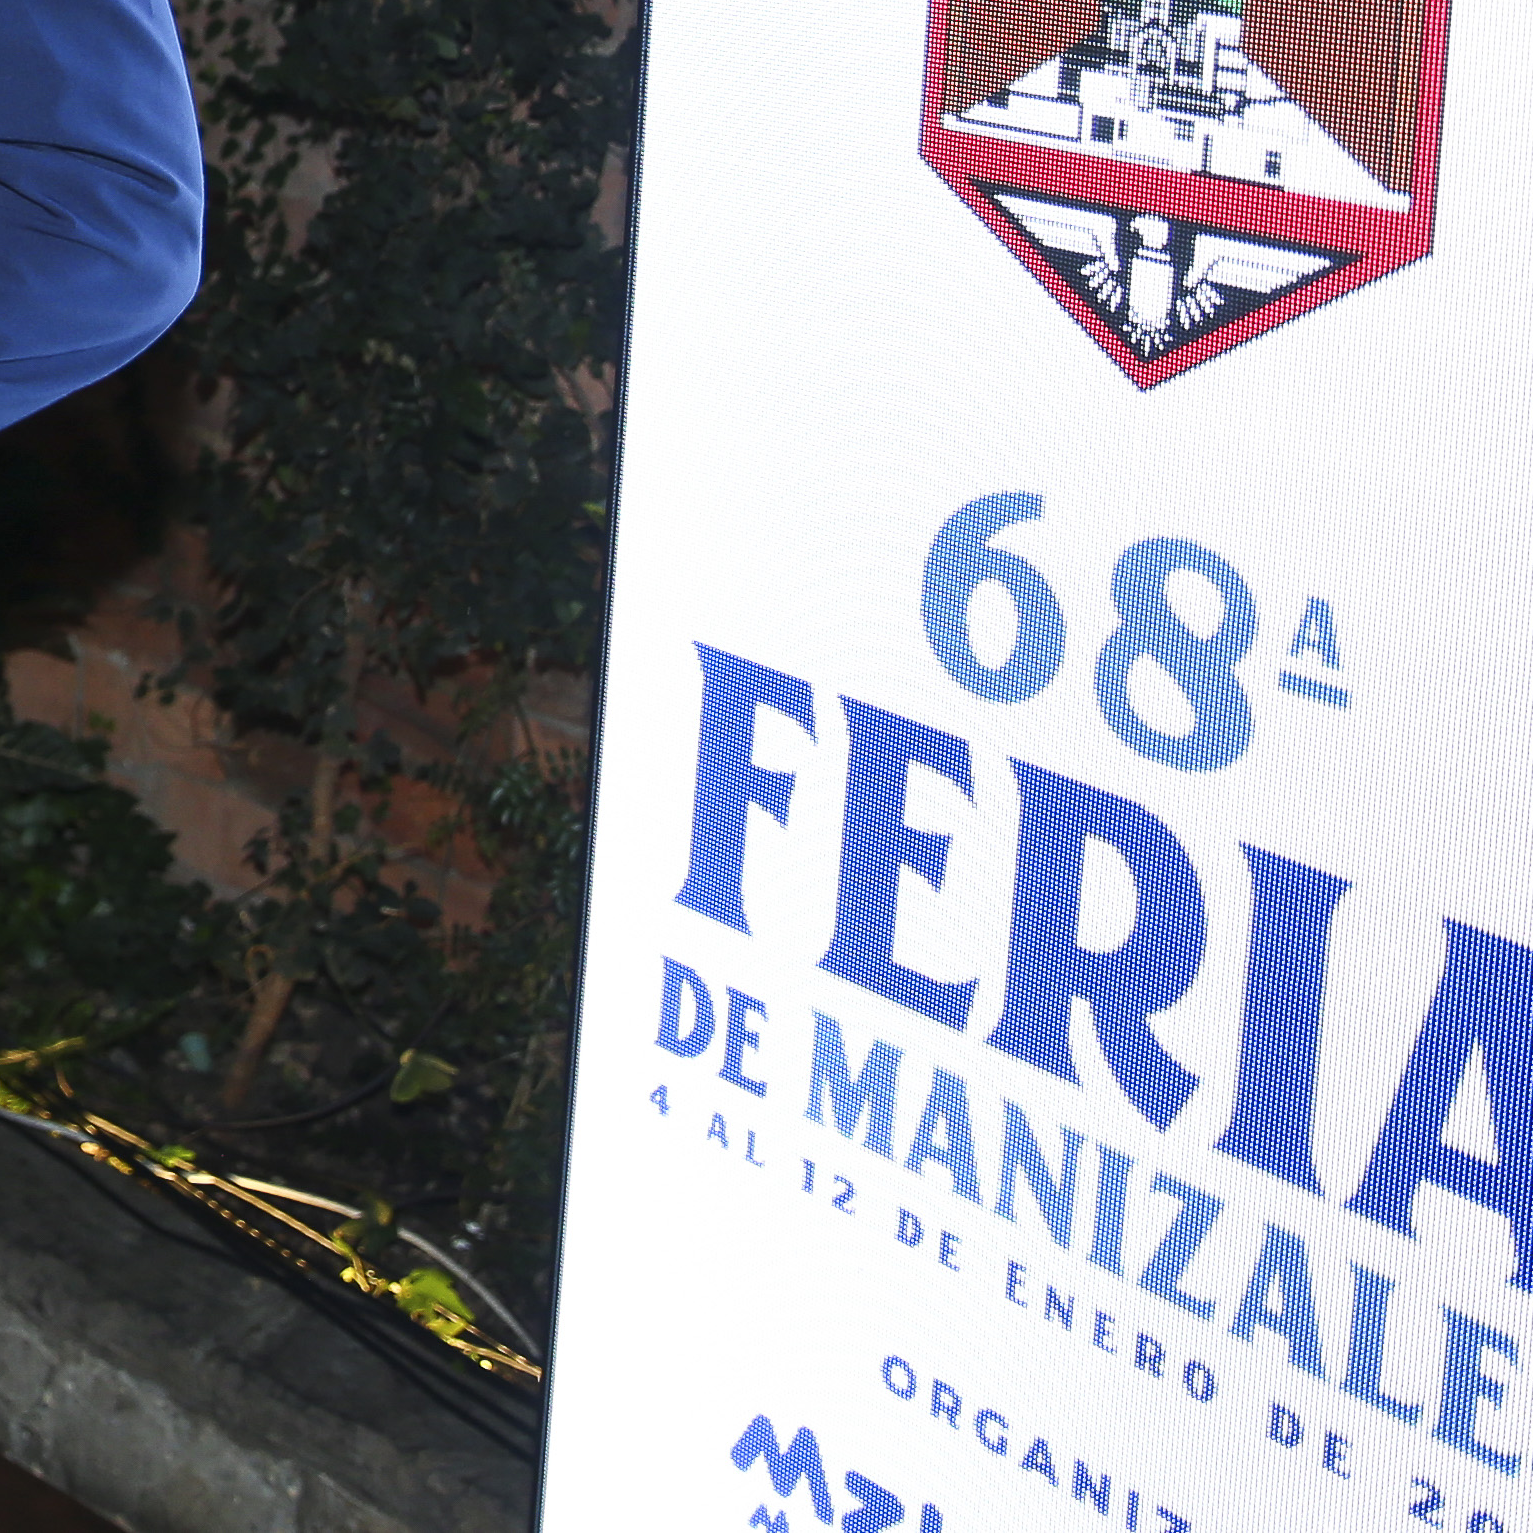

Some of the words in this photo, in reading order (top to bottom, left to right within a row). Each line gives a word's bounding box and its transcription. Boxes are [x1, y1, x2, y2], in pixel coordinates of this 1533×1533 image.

[654, 956, 768, 1099] DE
[804, 1010, 1533, 1480] MANIZALE
[674, 641, 1533, 1296] FERIA
[649, 1084, 671, 1116] 4
[707, 1112, 764, 1168] AL
[801, 1159, 856, 1214] 12
[895, 1207, 961, 1272] DE
[1005, 1259, 1219, 1405] ENERO
[1266, 1401, 1353, 1481] DE
